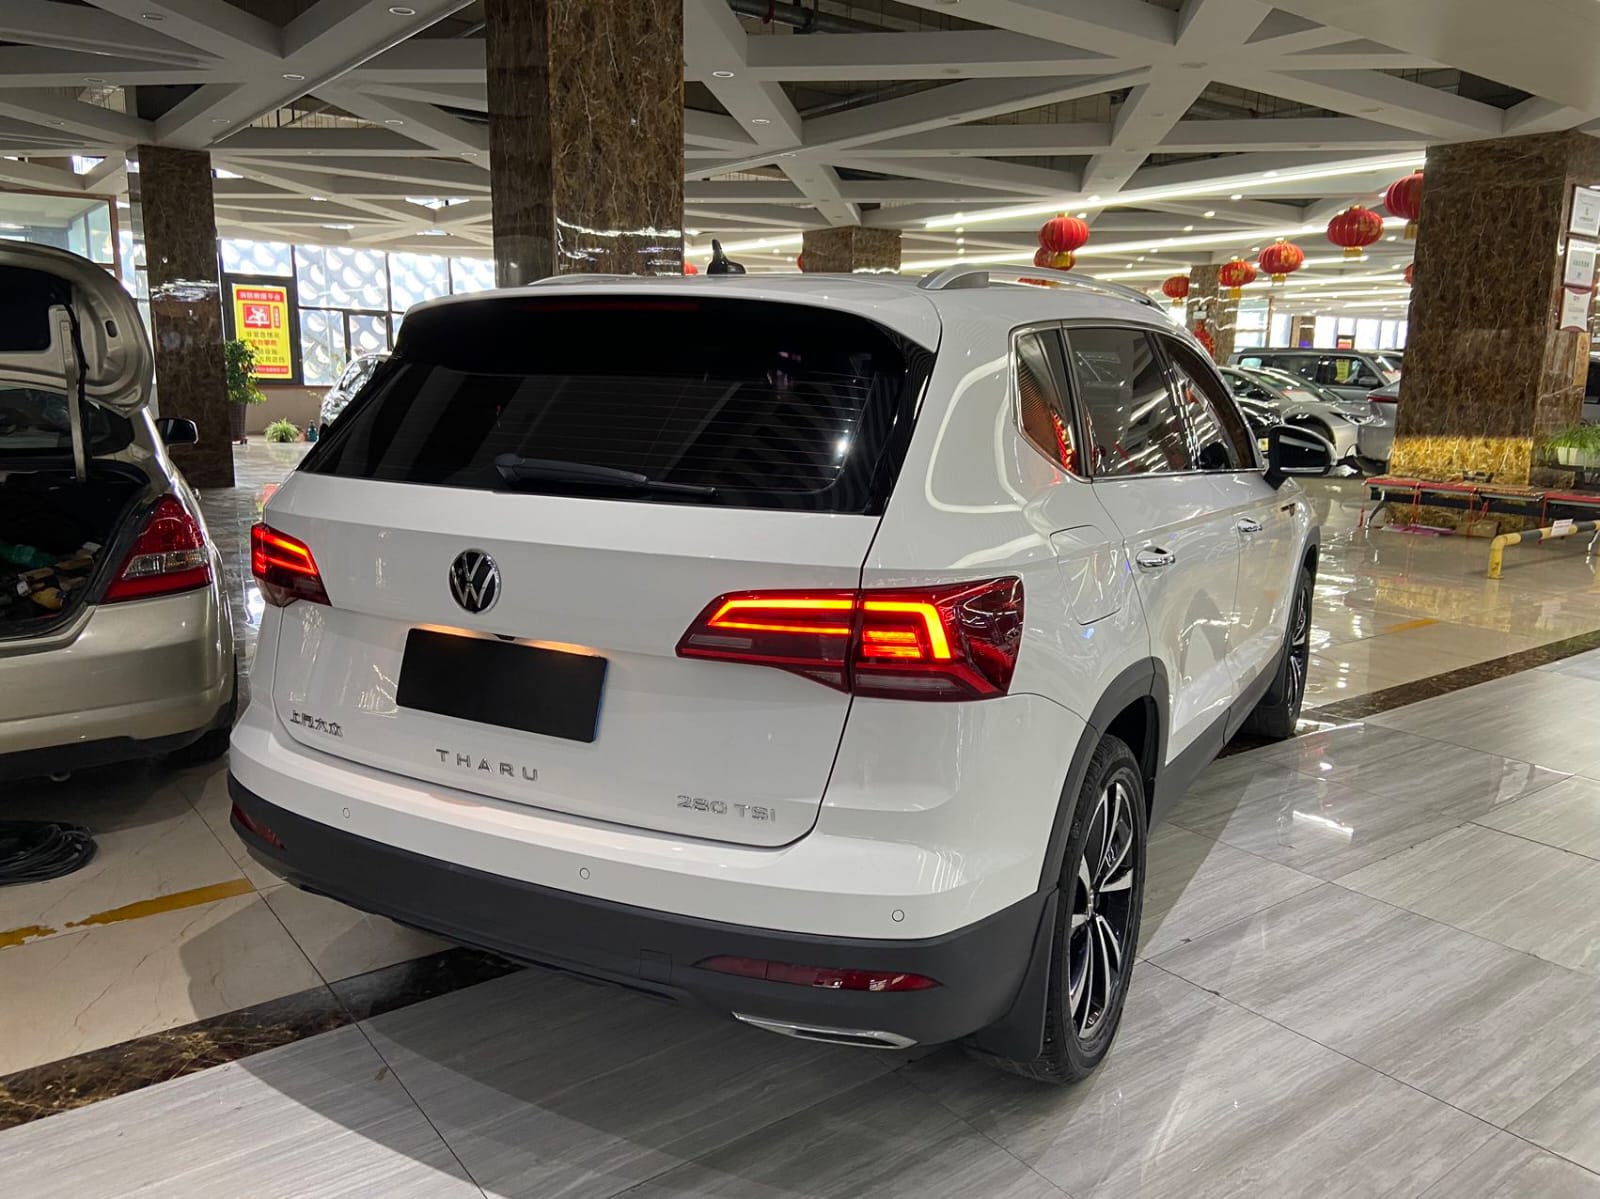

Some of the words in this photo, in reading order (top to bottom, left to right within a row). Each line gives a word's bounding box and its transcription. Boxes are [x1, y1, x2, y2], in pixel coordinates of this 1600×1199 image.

[436, 748, 538, 781] THARU
[676, 794, 728, 815] 280
[733, 803, 776, 822] TSI
